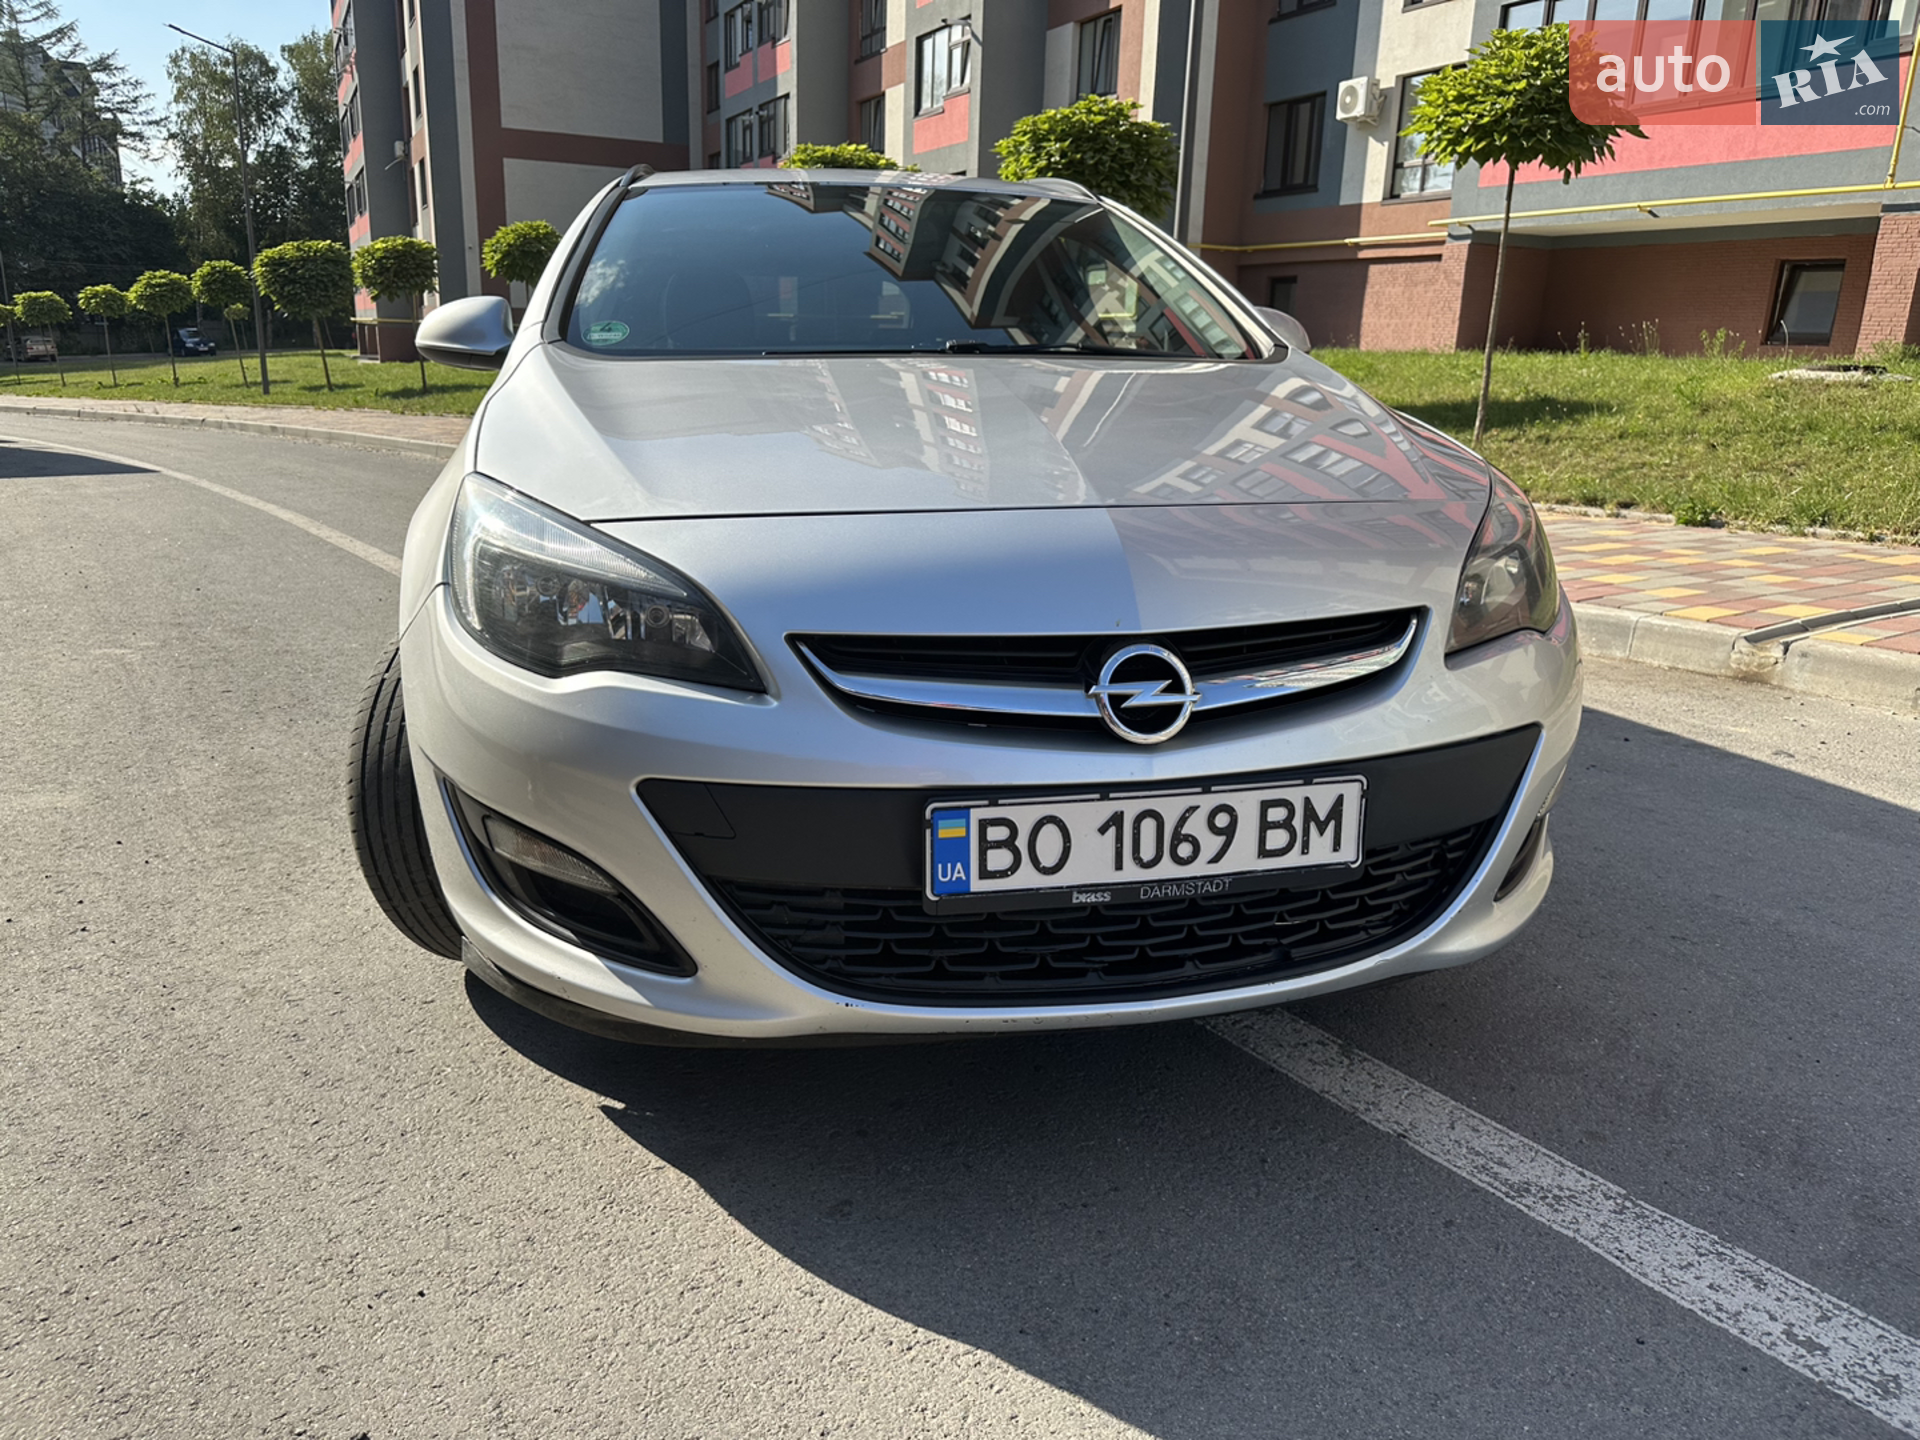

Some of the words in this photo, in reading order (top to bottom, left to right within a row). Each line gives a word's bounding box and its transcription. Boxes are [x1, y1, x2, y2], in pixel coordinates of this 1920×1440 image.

[978, 816, 1072, 880] BO
[1097, 803, 1239, 871] 1069
[1257, 792, 1345, 859] BM
[938, 861, 967, 882] UA
[1140, 878, 1233, 900] DARMSTADT
